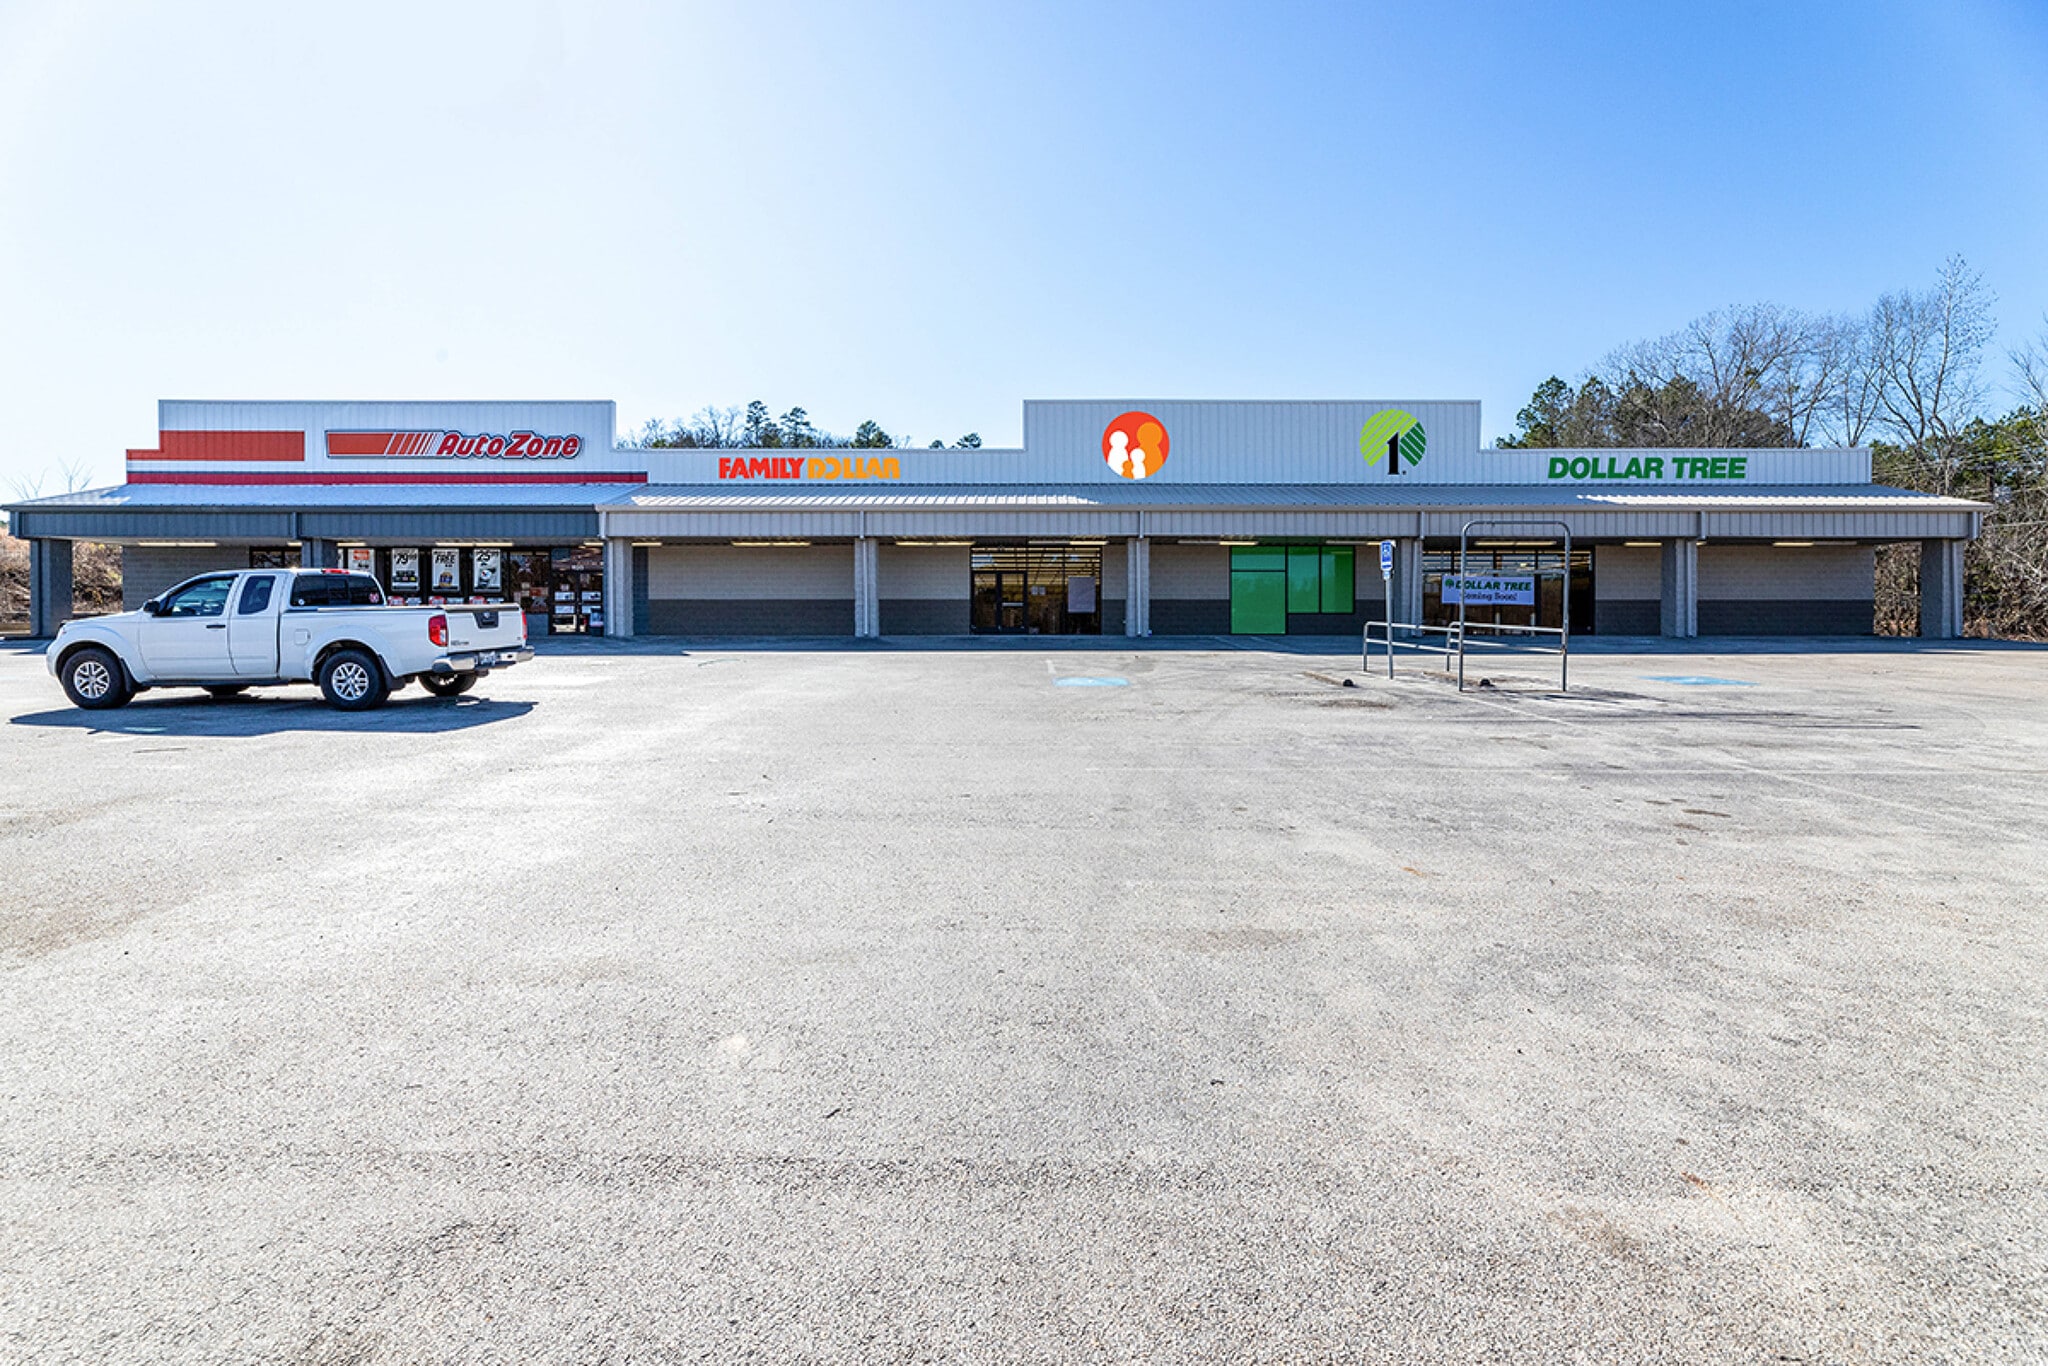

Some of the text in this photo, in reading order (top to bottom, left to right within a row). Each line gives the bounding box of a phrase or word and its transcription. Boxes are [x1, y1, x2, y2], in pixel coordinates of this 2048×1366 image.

[436, 433, 580, 458] AutoZone
[718, 457, 900, 480] FAMILY DOLLAR
[1548, 457, 1747, 480] DOLLAR TREE
[1504, 581, 1532, 591] TREE
